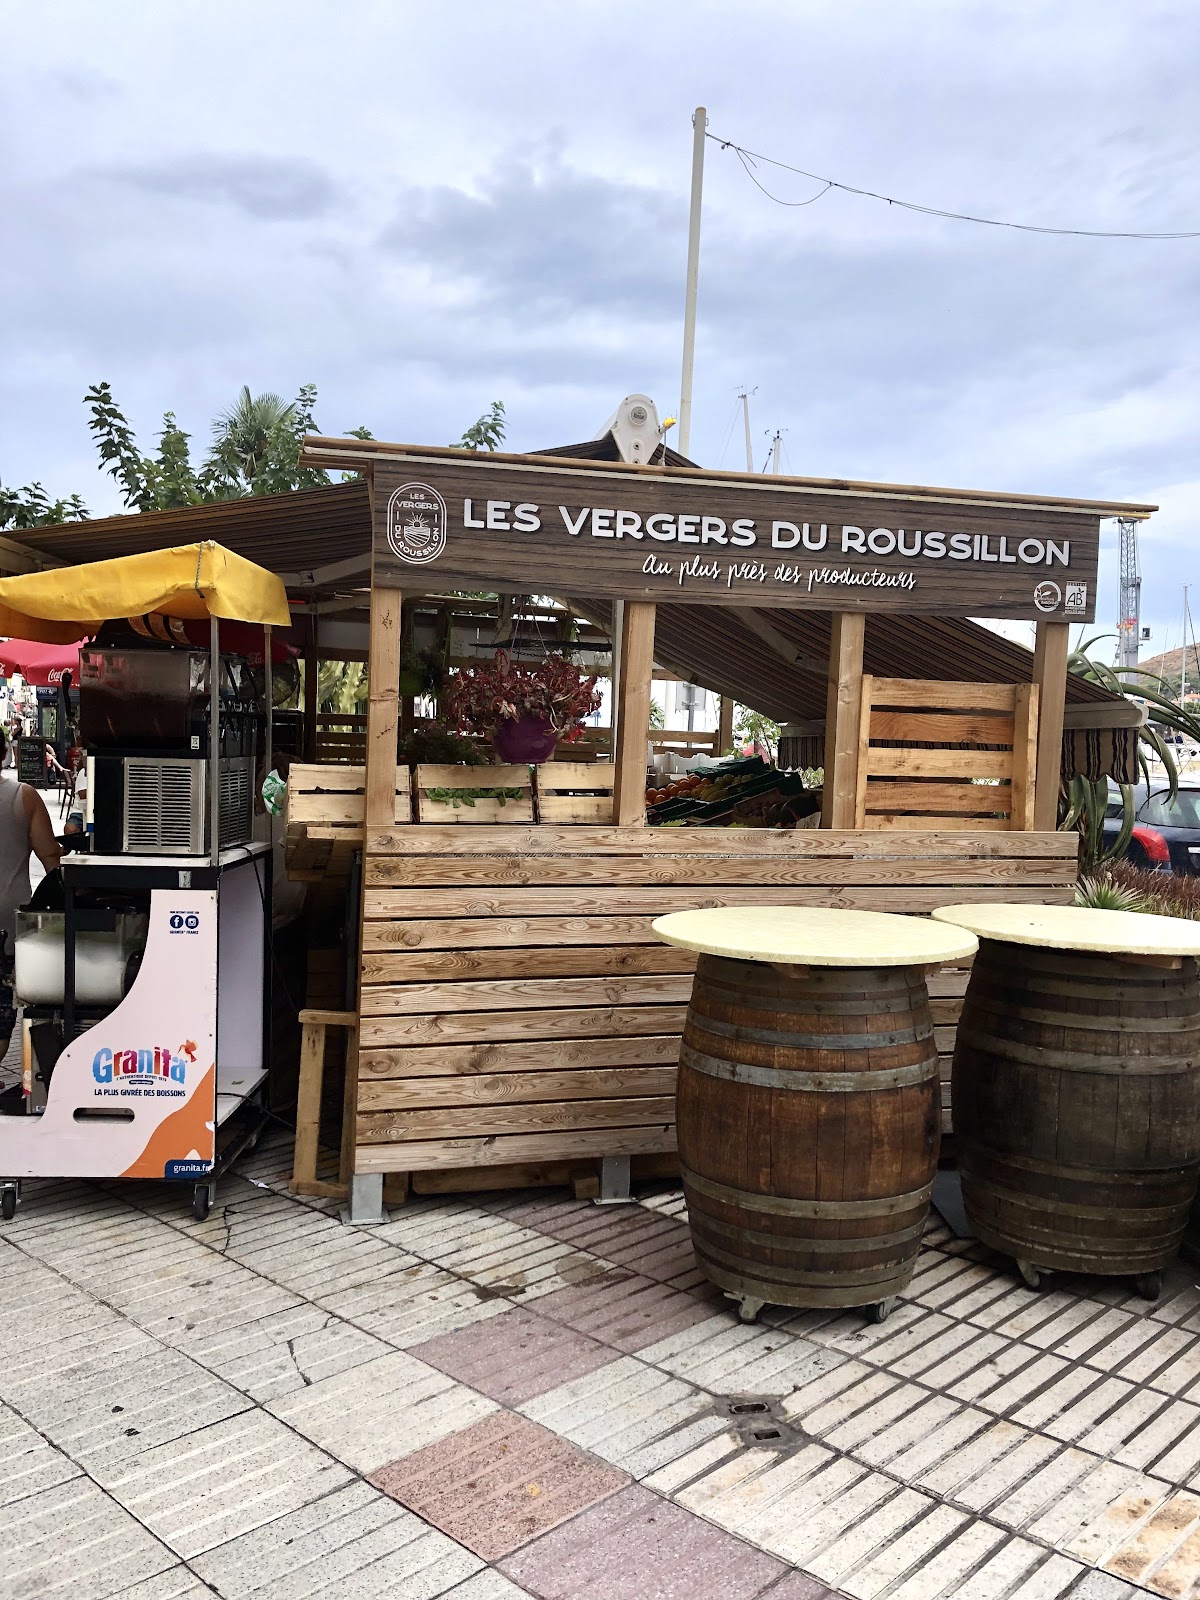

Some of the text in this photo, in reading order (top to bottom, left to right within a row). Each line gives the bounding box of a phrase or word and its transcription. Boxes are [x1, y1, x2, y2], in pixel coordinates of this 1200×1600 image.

[396, 500, 439, 510] VERGERS
[394, 525, 440, 557] DU ROUSSILLON
[463, 498, 1070, 567] LES VERGERS DU ROUSSILLON
[678, 554, 721, 585] plus
[727, 560, 768, 588] près
[773, 562, 802, 584] des
[807, 566, 917, 592] producteurs
[92, 1046, 187, 1085] Granita
[94, 1088, 103, 1096] LA
[120, 1088, 143, 1097] GIVRÉE
[143, 1089, 156, 1097] DES
[156, 1089, 186, 1097] BOISSONS
